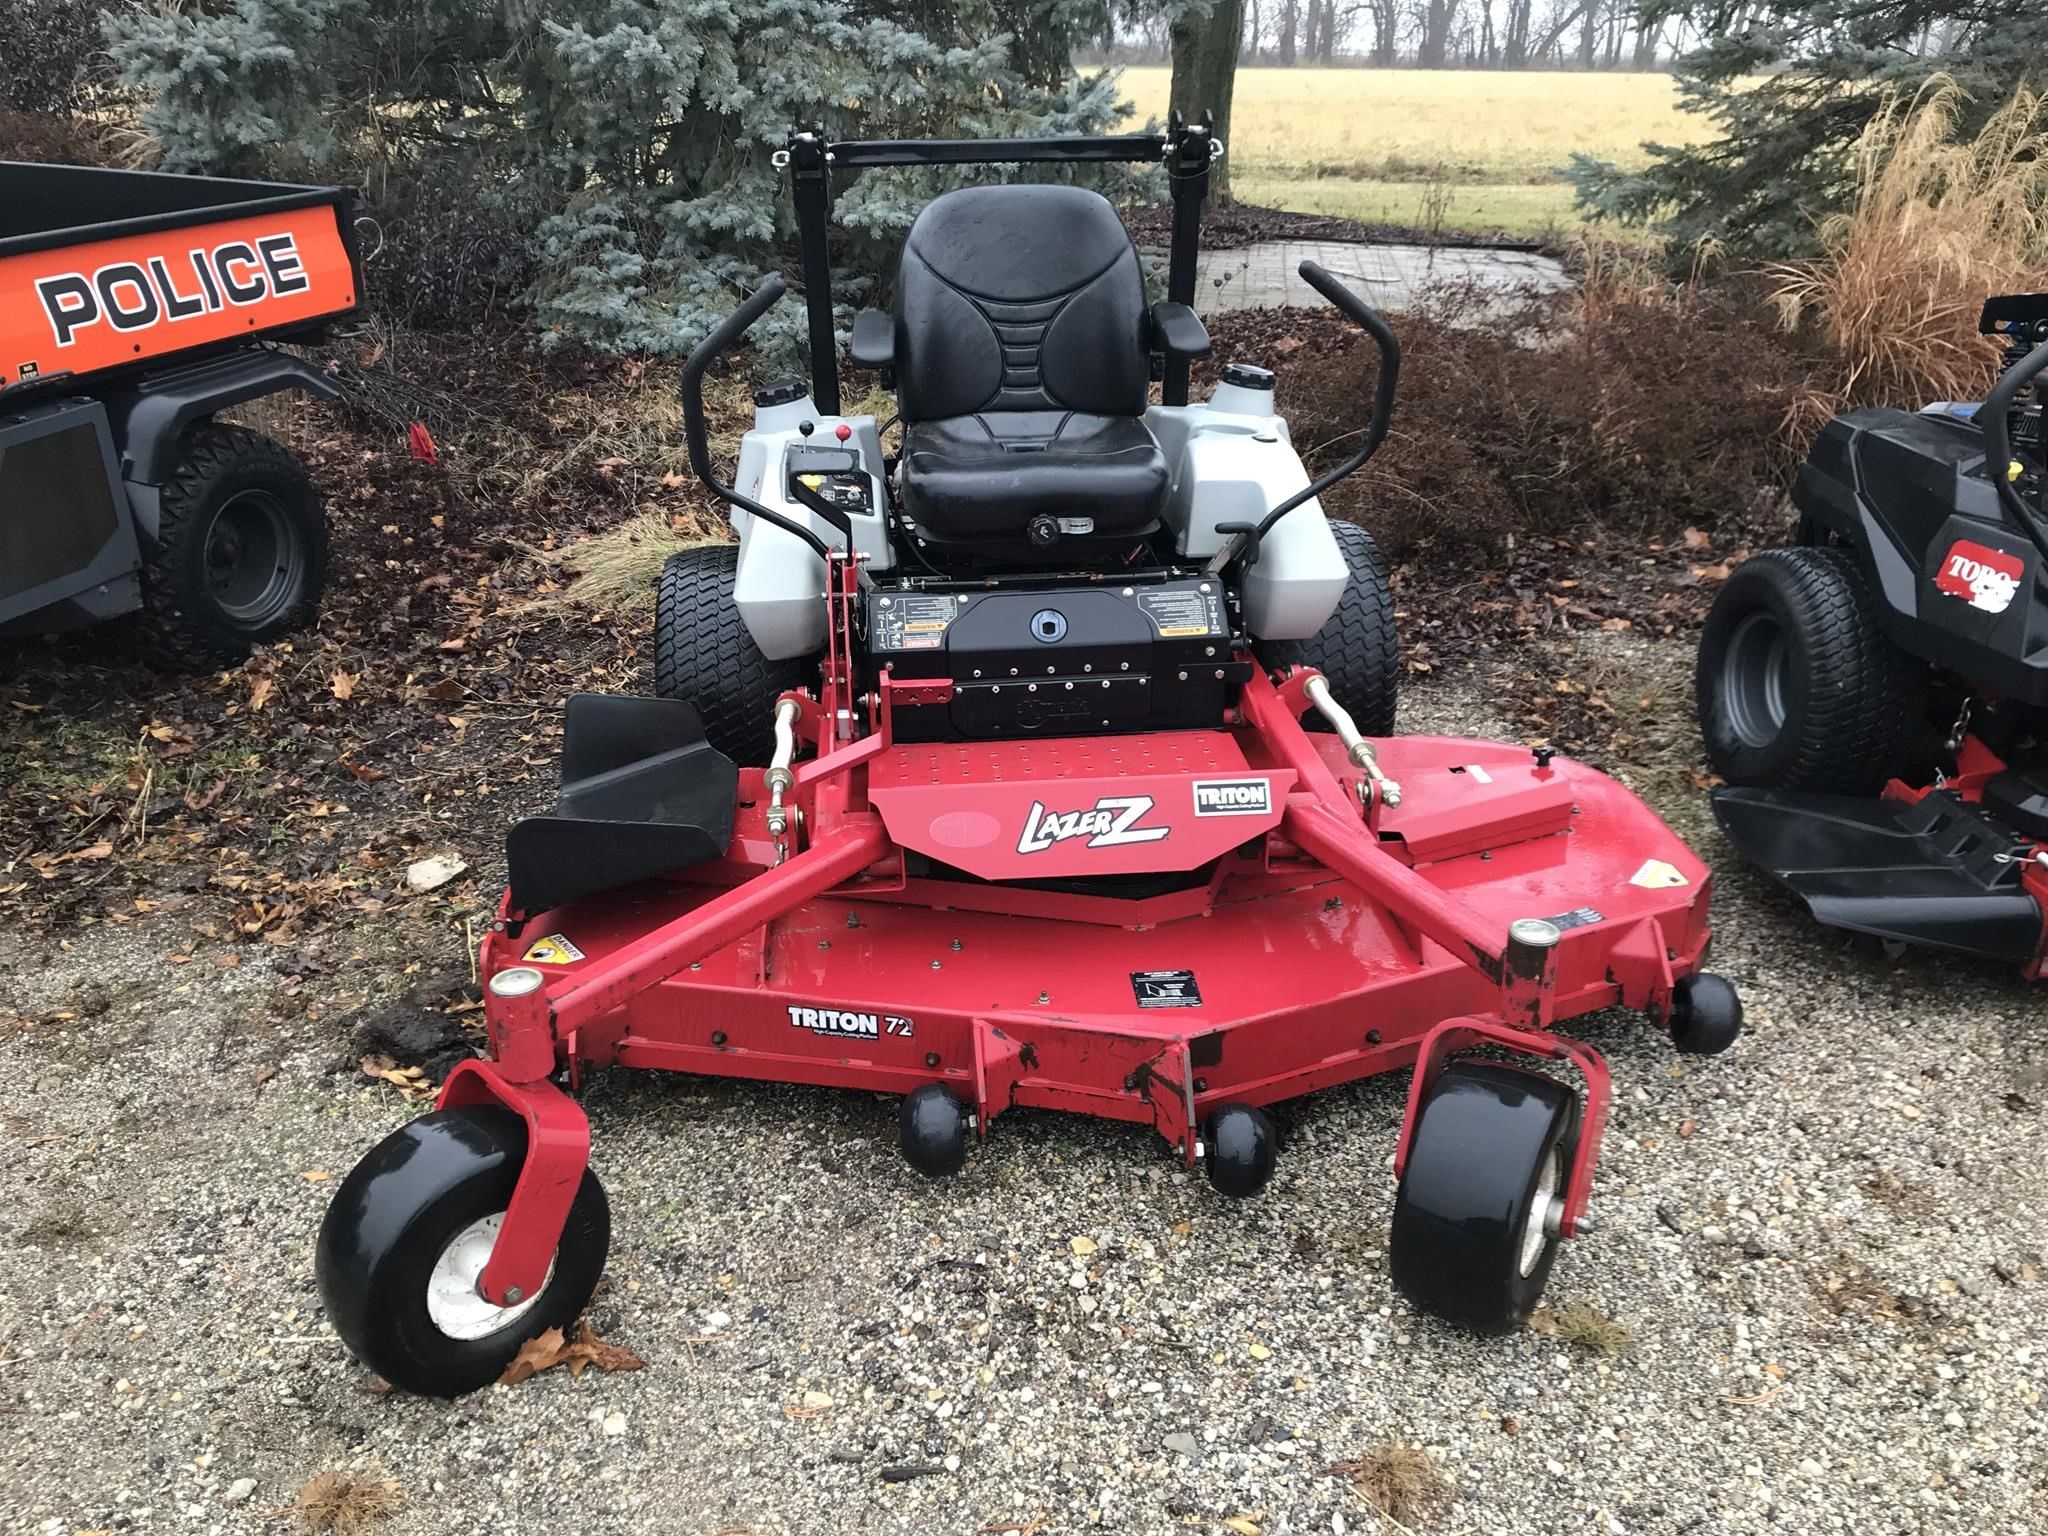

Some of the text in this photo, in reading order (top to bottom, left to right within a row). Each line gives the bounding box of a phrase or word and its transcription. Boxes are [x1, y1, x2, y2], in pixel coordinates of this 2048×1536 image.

[34, 232, 311, 348] POLICE
[23, 364, 34, 372] NO
[1198, 786, 1265, 805] TRITON
[553, 934, 581, 959] DANGER
[787, 1006, 914, 1036] TRITON 72
